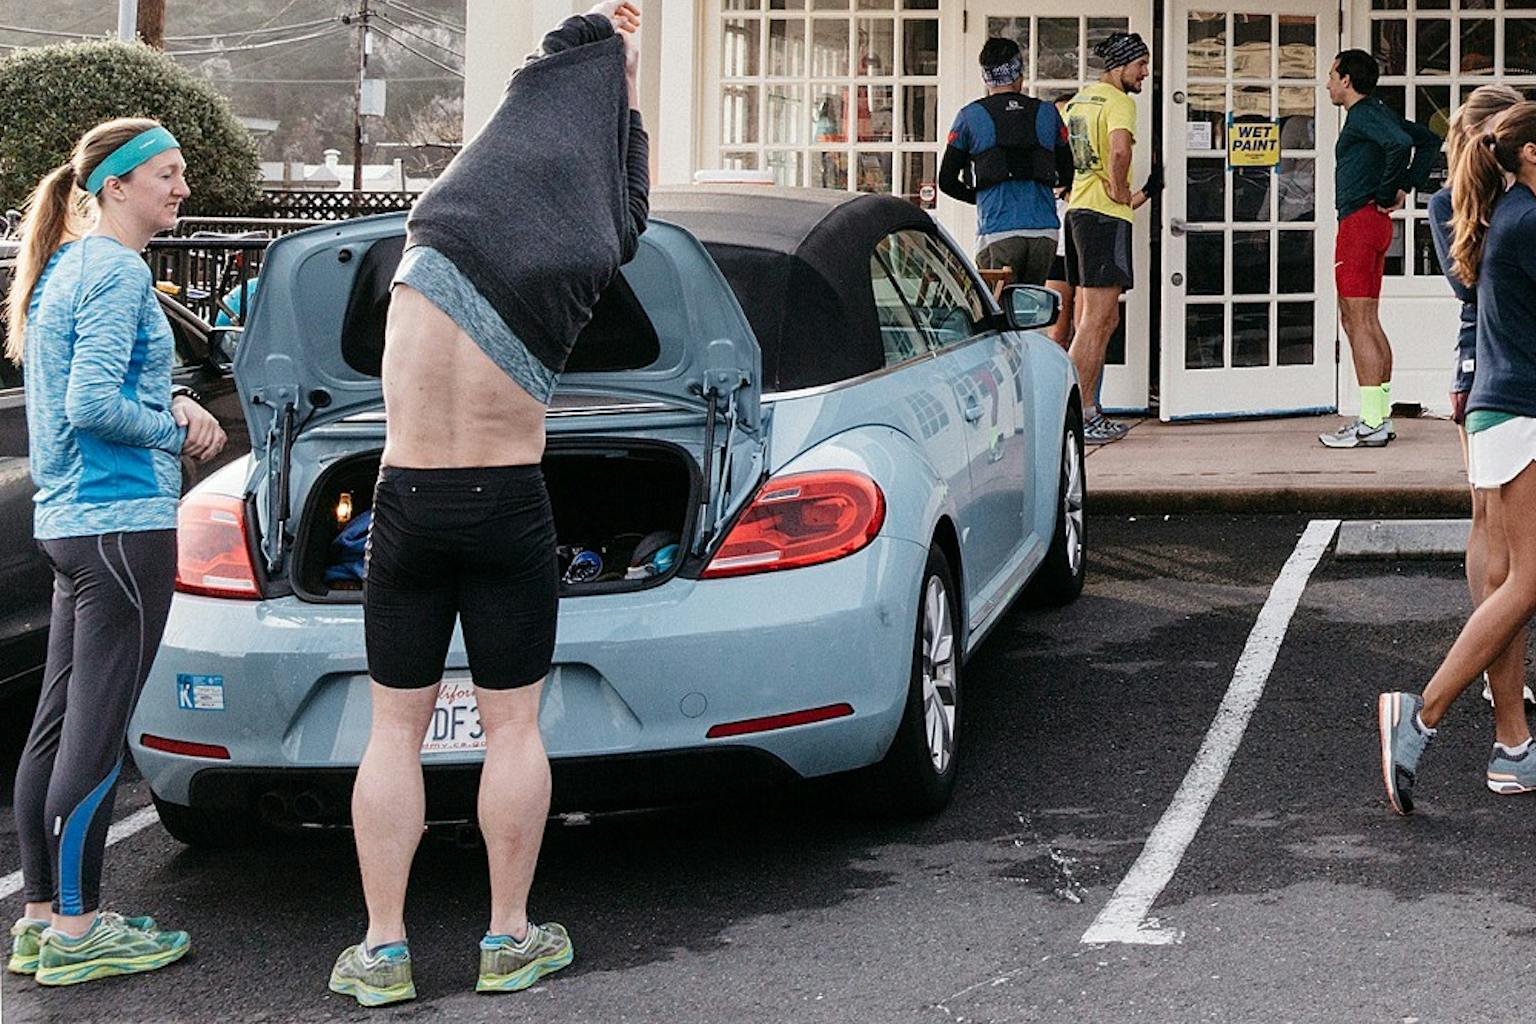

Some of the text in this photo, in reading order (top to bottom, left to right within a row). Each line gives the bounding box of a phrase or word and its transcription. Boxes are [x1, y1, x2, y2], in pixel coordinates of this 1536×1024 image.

[1238, 126, 1272, 138] WET
[1232, 140, 1277, 151] PAINT
[433, 706, 484, 740] DF3
